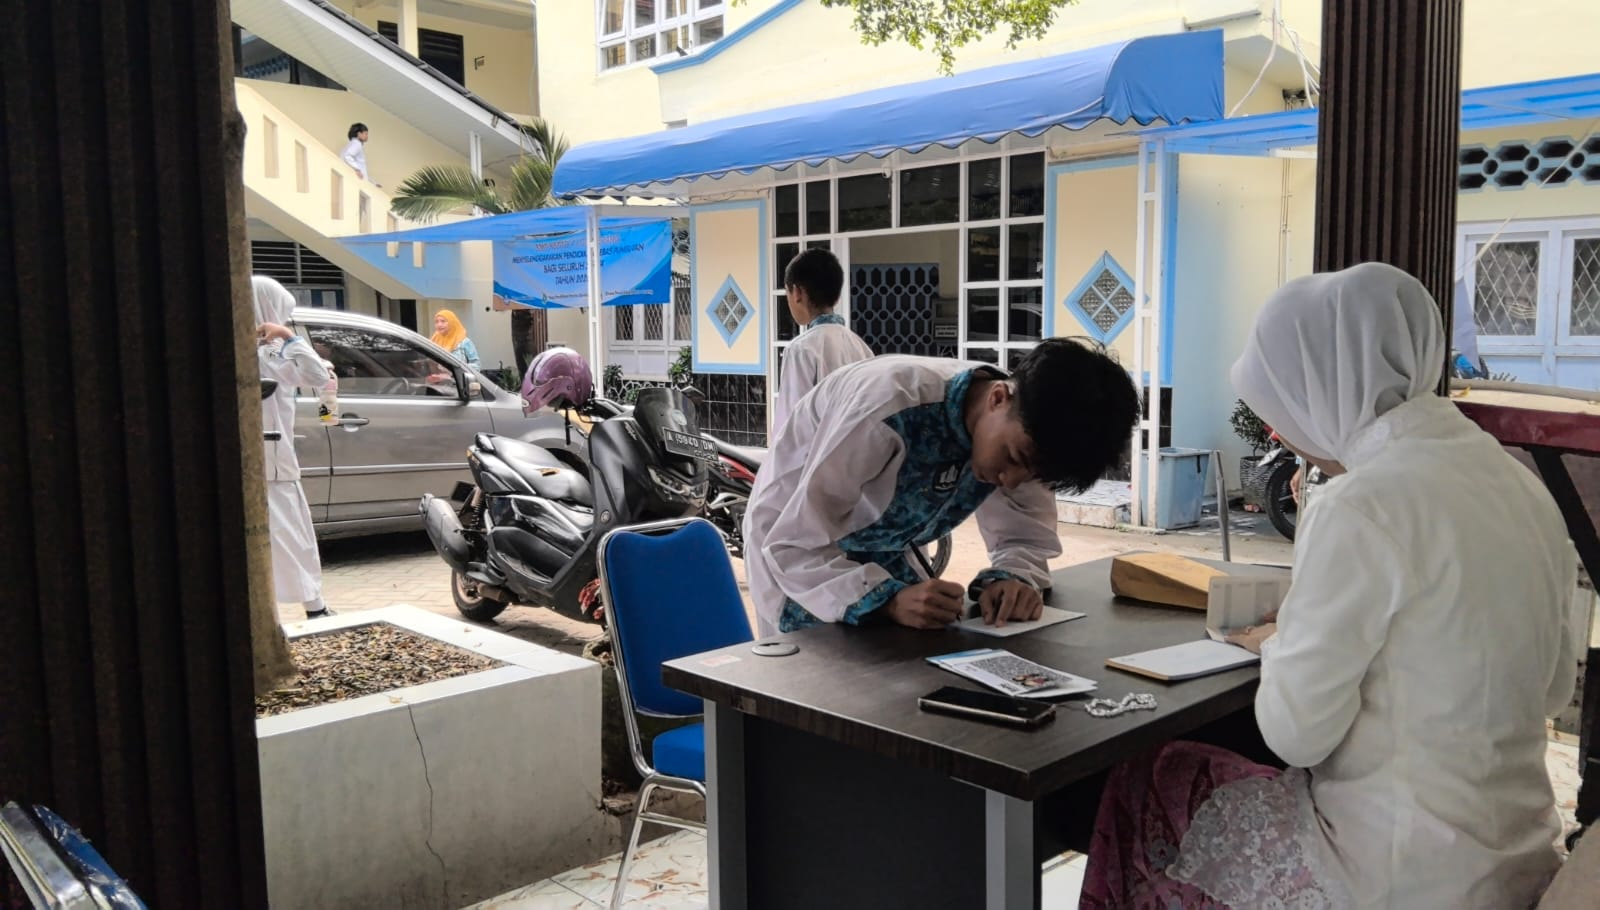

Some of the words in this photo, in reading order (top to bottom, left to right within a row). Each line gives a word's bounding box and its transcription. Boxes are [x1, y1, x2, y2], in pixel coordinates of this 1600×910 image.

[600, 247, 613, 256] EBAS
[543, 264, 557, 273] BAGI
[558, 262, 585, 272] SELURUH
[555, 275, 576, 286] TAHUN
